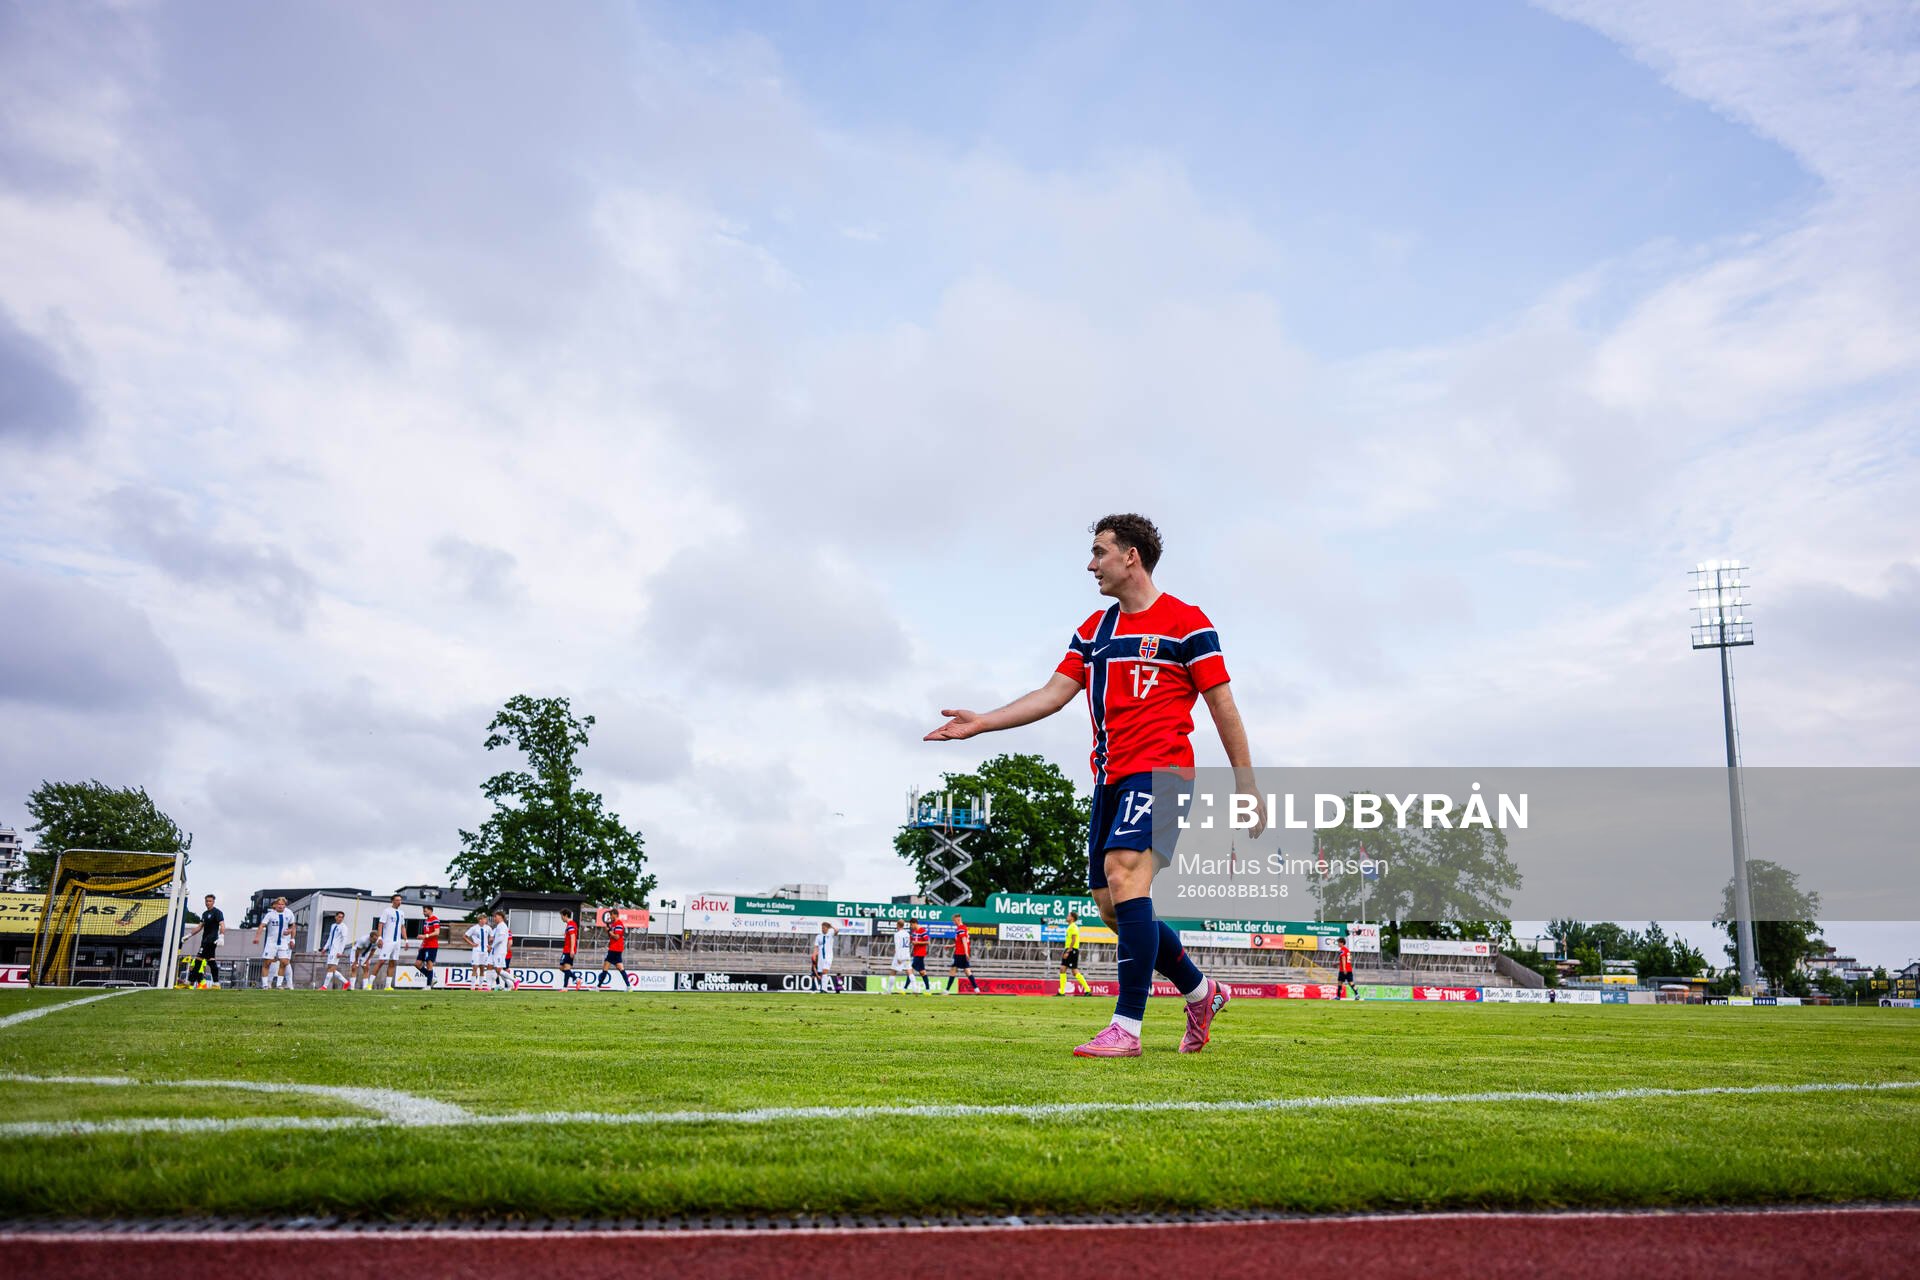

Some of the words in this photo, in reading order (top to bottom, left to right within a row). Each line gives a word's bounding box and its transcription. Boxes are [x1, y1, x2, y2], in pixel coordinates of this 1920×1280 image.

[1130, 664, 1160, 700] 17
[1124, 791, 1156, 826] 17
[836, 903, 854, 917] En
[888, 905, 909, 919] der
[911, 906, 927, 920] du
[929, 910, 942, 920] er
[995, 896, 1051, 916] Marker
[1053, 899, 1065, 916] &
[1068, 900, 1102, 918] Eids
[744, 919, 781, 928] eurofins
[1006, 925, 1033, 933] NORDIC
[1218, 920, 1243, 932] bank
[1244, 921, 1261, 932] der
[1261, 921, 1275, 933] du
[1275, 924, 1287, 934] er
[1006, 932, 1025, 940] PACK
[696, 980, 759, 992] Graveservice
[1233, 986, 1262, 996] VIKING
[1443, 989, 1466, 1000] TINE
